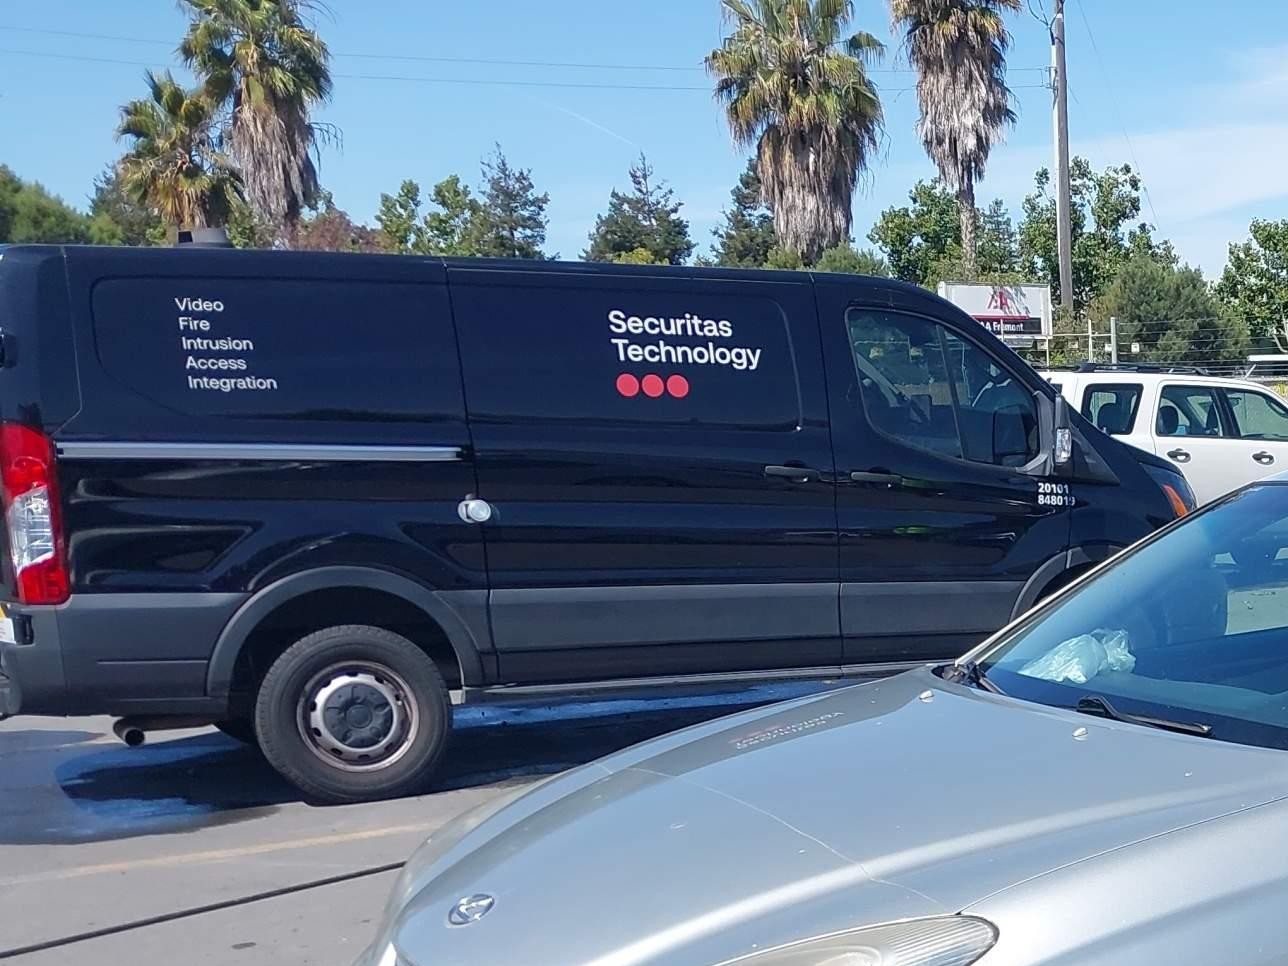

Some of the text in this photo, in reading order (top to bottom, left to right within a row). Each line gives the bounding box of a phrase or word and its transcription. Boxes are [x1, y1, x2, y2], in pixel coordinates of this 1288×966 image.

[174, 297, 224, 312] Video
[178, 316, 211, 331] Fire
[608, 310, 733, 337] Securitas
[181, 336, 254, 351] Intrusion
[611, 338, 762, 370] Technology
[185, 355, 248, 370] Access
[187, 375, 278, 393] Integration
[1037, 482, 1069, 494] 20101
